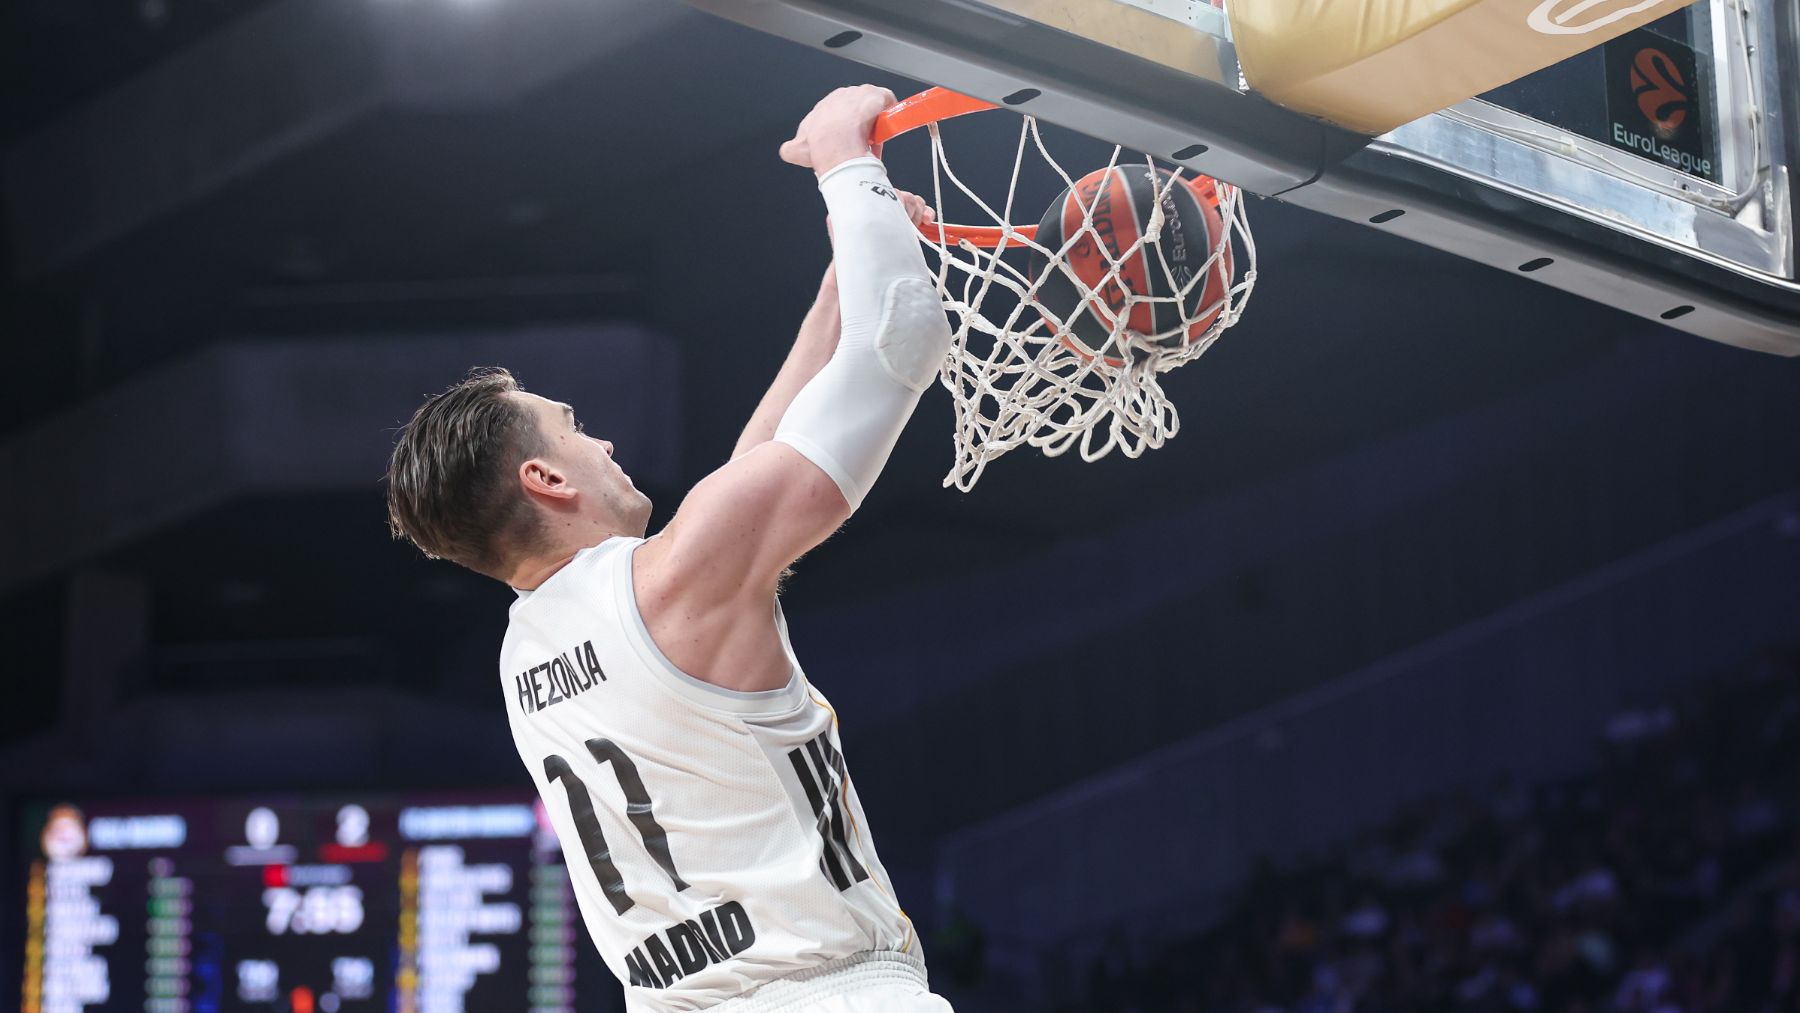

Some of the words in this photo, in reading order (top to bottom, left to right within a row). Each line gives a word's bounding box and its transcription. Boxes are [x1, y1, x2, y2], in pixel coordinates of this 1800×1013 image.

[1613, 122, 1711, 175] EuroLeague
[515, 639, 608, 717] HEZONJA
[543, 737, 691, 916] 11
